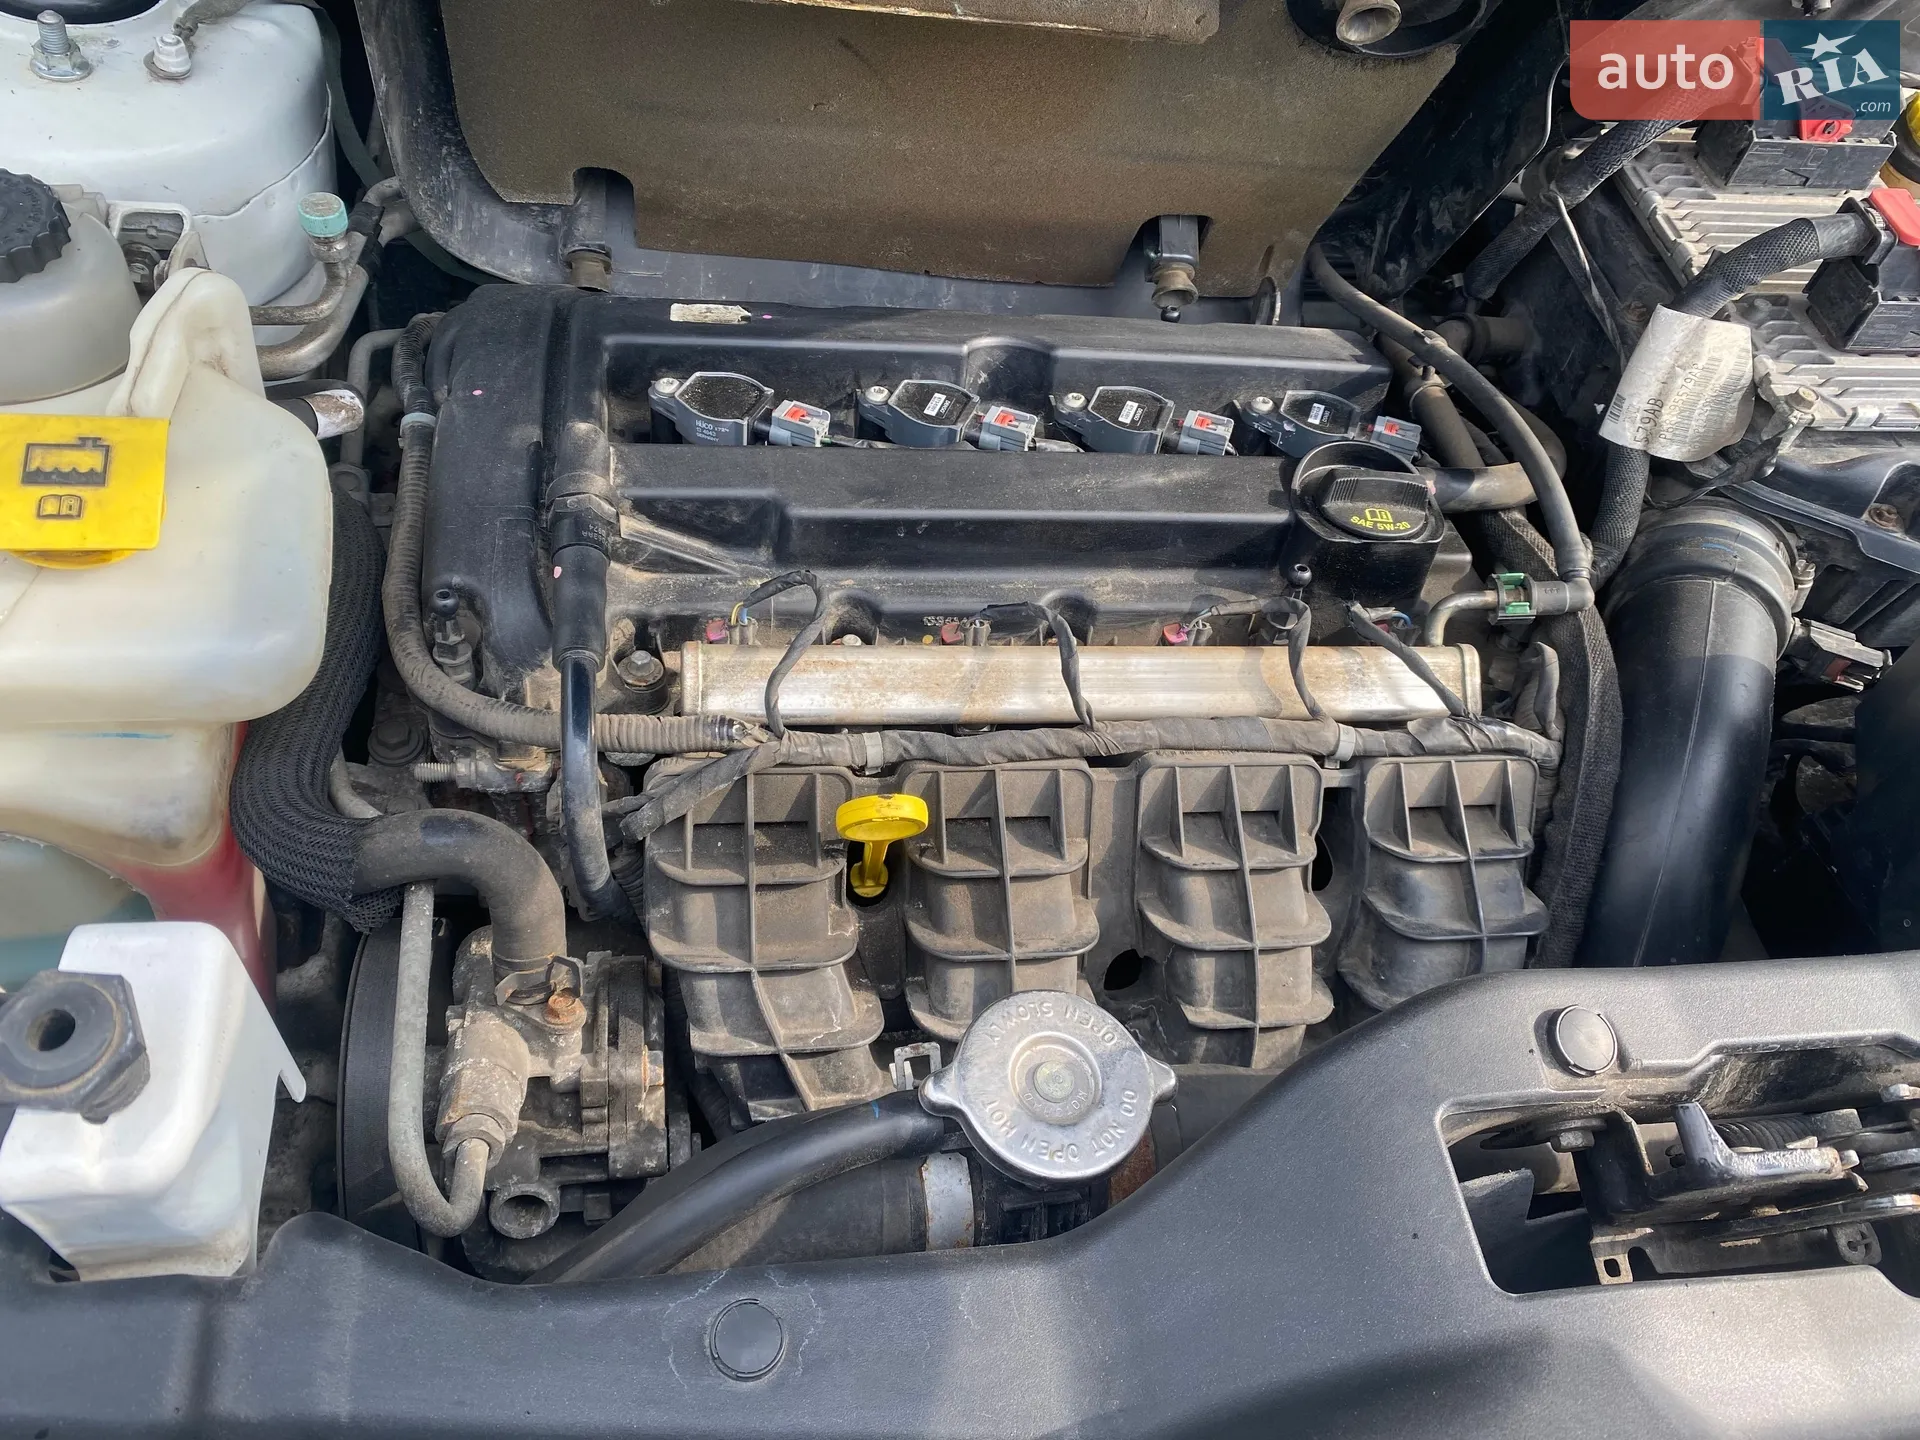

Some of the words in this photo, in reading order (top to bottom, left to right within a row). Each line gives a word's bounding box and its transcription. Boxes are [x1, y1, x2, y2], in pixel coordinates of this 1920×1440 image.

[1633, 397, 1664, 446] 579AB
[1350, 515, 1374, 529] SAE
[1377, 520, 1411, 531] 5W-20
[984, 1001, 1055, 1046] SLOWLY
[1063, 1003, 1118, 1047] OPEN
[983, 1100, 1017, 1139] HOT
[1119, 1088, 1140, 1118] DO
[1020, 1132, 1080, 1163] OPEN
[1089, 1121, 1127, 1157] NOT
